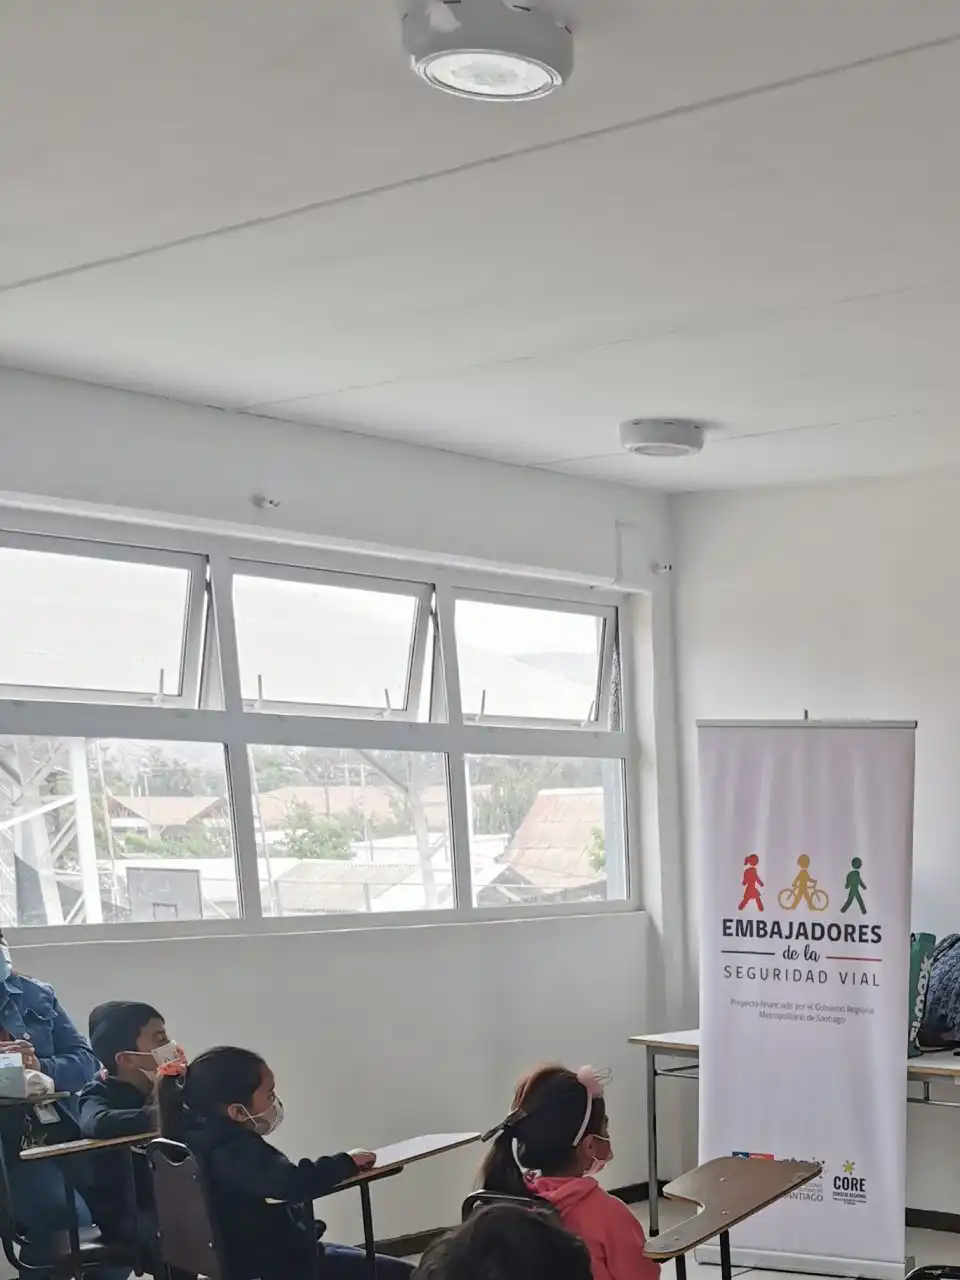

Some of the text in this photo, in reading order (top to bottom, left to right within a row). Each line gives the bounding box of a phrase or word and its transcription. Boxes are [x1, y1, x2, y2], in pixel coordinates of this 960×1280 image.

[722, 918, 883, 944] EMBAJADORES
[782, 943, 821, 963] de la
[723, 965, 880, 987] SEGURIDAD VIAL
[730, 997, 760, 1009] Proyecto
[814, 1002, 846, 1013] Gobierno
[816, 1013, 846, 1026] Santiago
[833, 1175, 867, 1193] CORE
